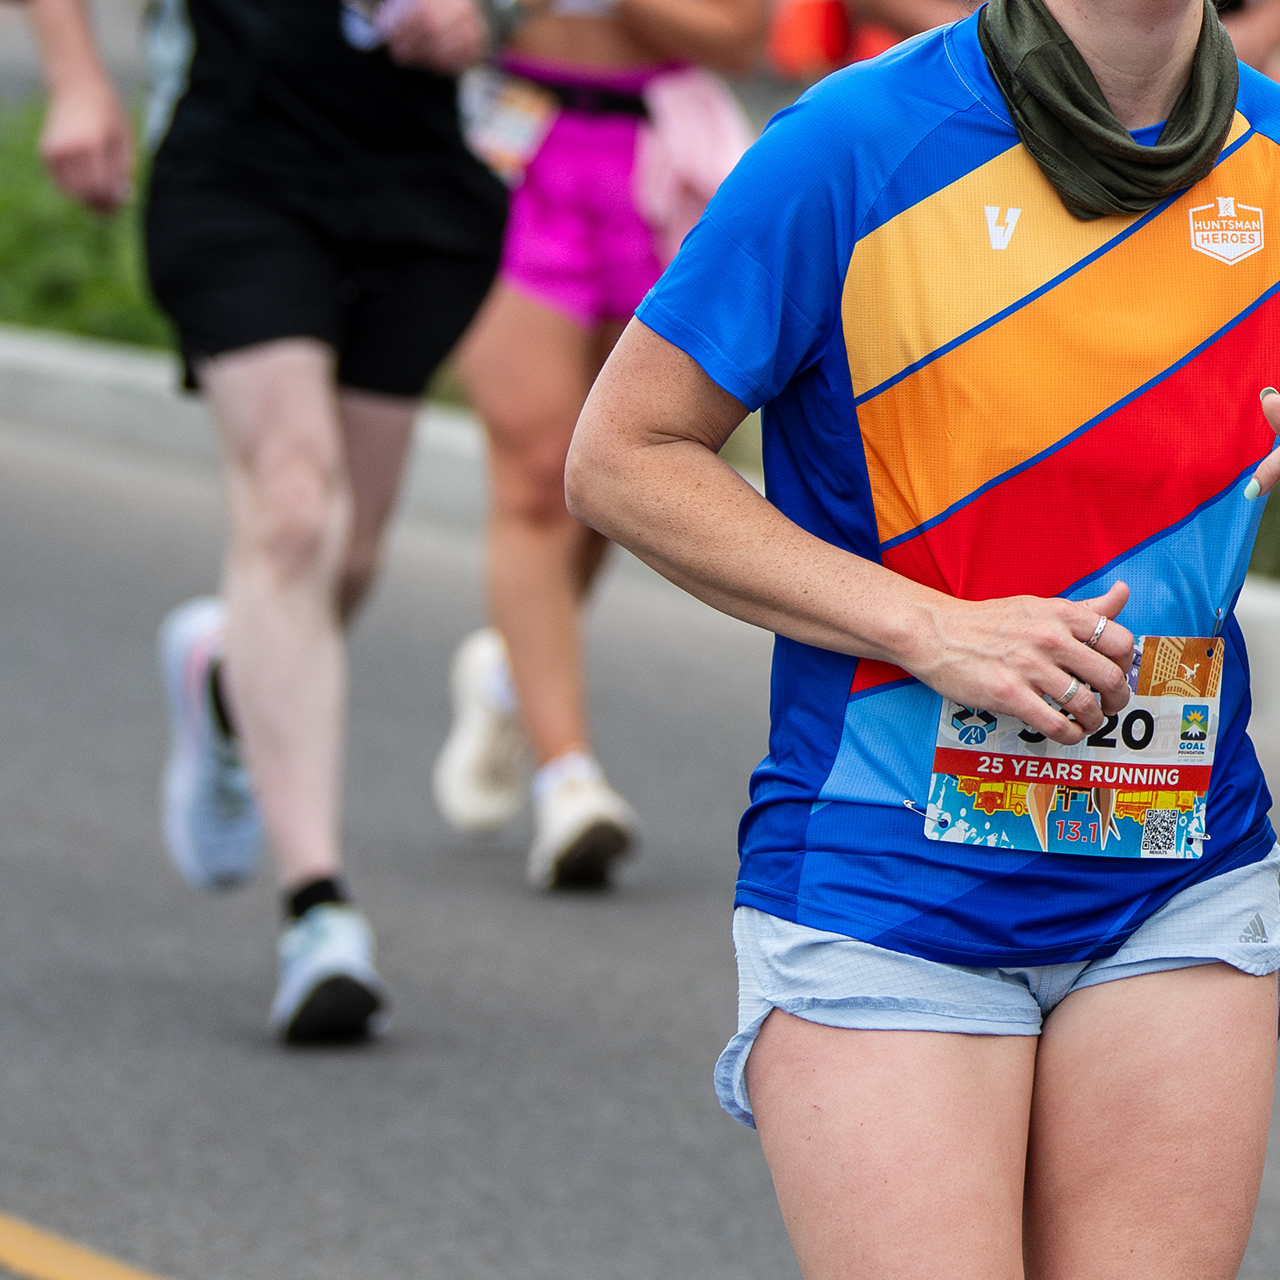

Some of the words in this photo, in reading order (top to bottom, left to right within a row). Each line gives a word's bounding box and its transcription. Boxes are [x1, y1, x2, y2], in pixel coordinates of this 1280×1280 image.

[1194, 220, 1260, 230] HUNTSMAN
[1201, 233, 1255, 244] HEROES
[1179, 742, 1206, 751] GOAL
[977, 756, 1004, 774] 25
[1011, 759, 1083, 781] YEARS
[1089, 766, 1180, 786] RUNNING
[1055, 820, 1098, 843] 13.1
